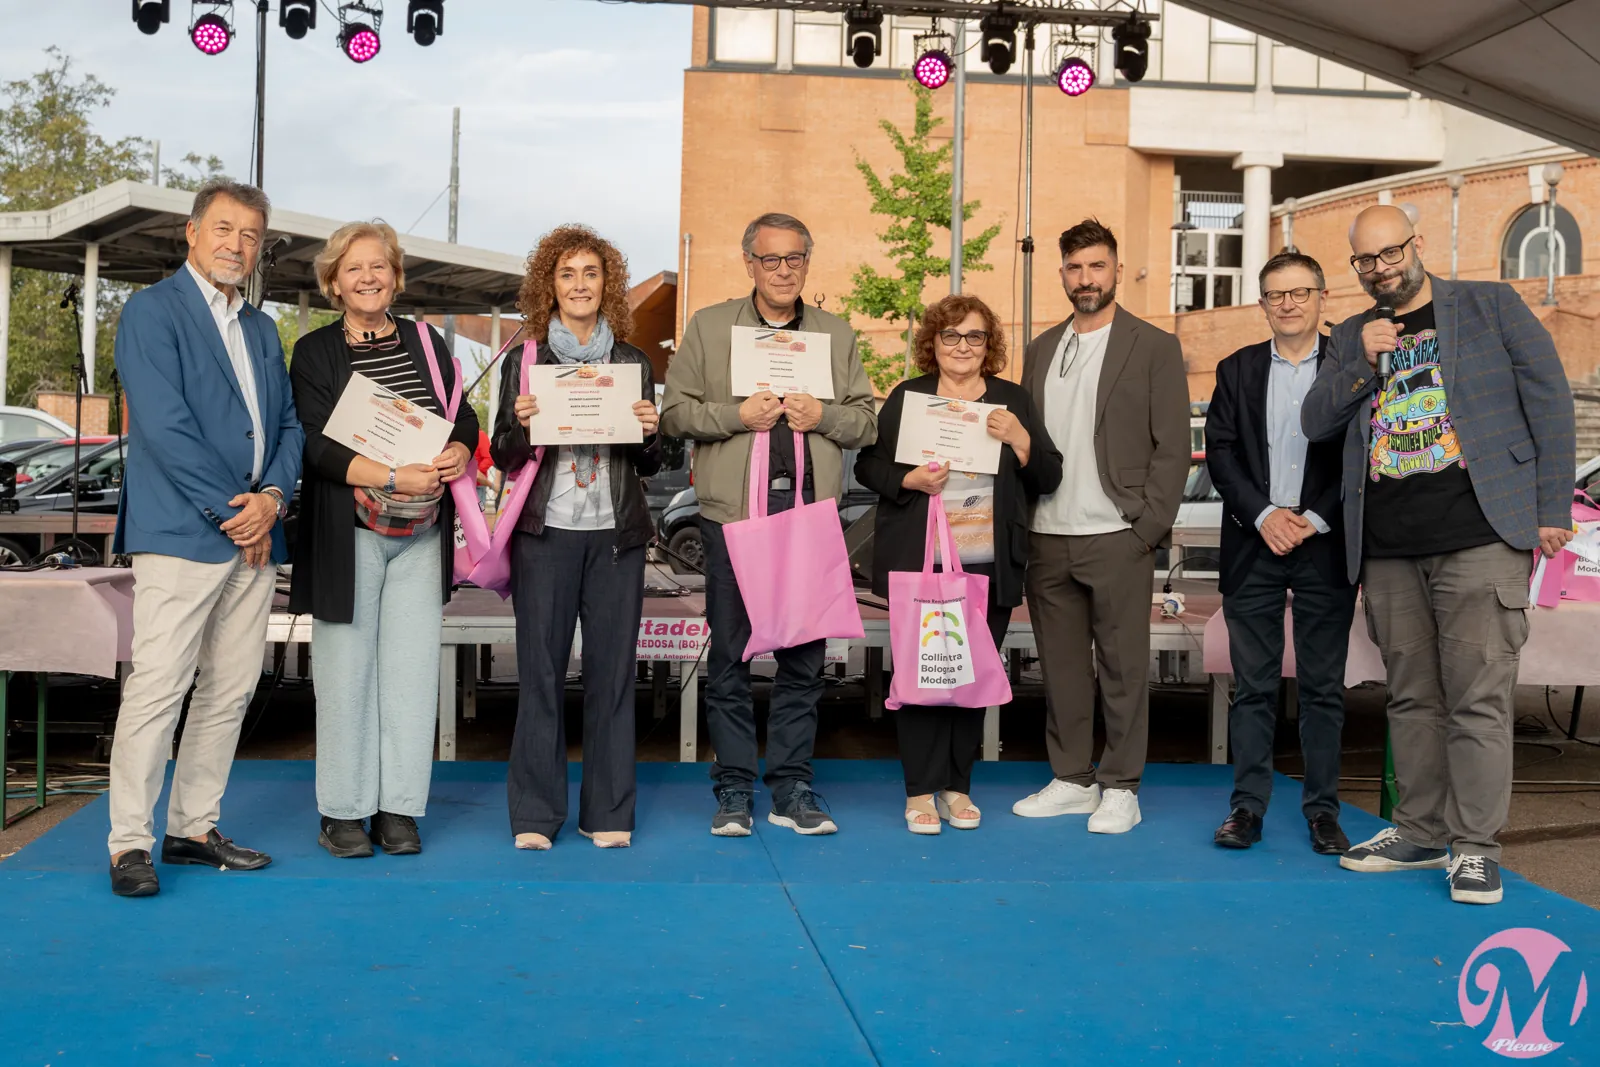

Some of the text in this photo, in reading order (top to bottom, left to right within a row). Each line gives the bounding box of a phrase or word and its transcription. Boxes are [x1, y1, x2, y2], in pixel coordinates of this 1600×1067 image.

[1400, 452, 1431, 473] GROOVY
[1577, 565, 1600, 573] Mode
[639, 620, 709, 636] tadel
[636, 639, 674, 648] REDOSA
[678, 640, 699, 650] (BO)
[921, 653, 963, 662] Collintra
[920, 676, 957, 684] Modena
